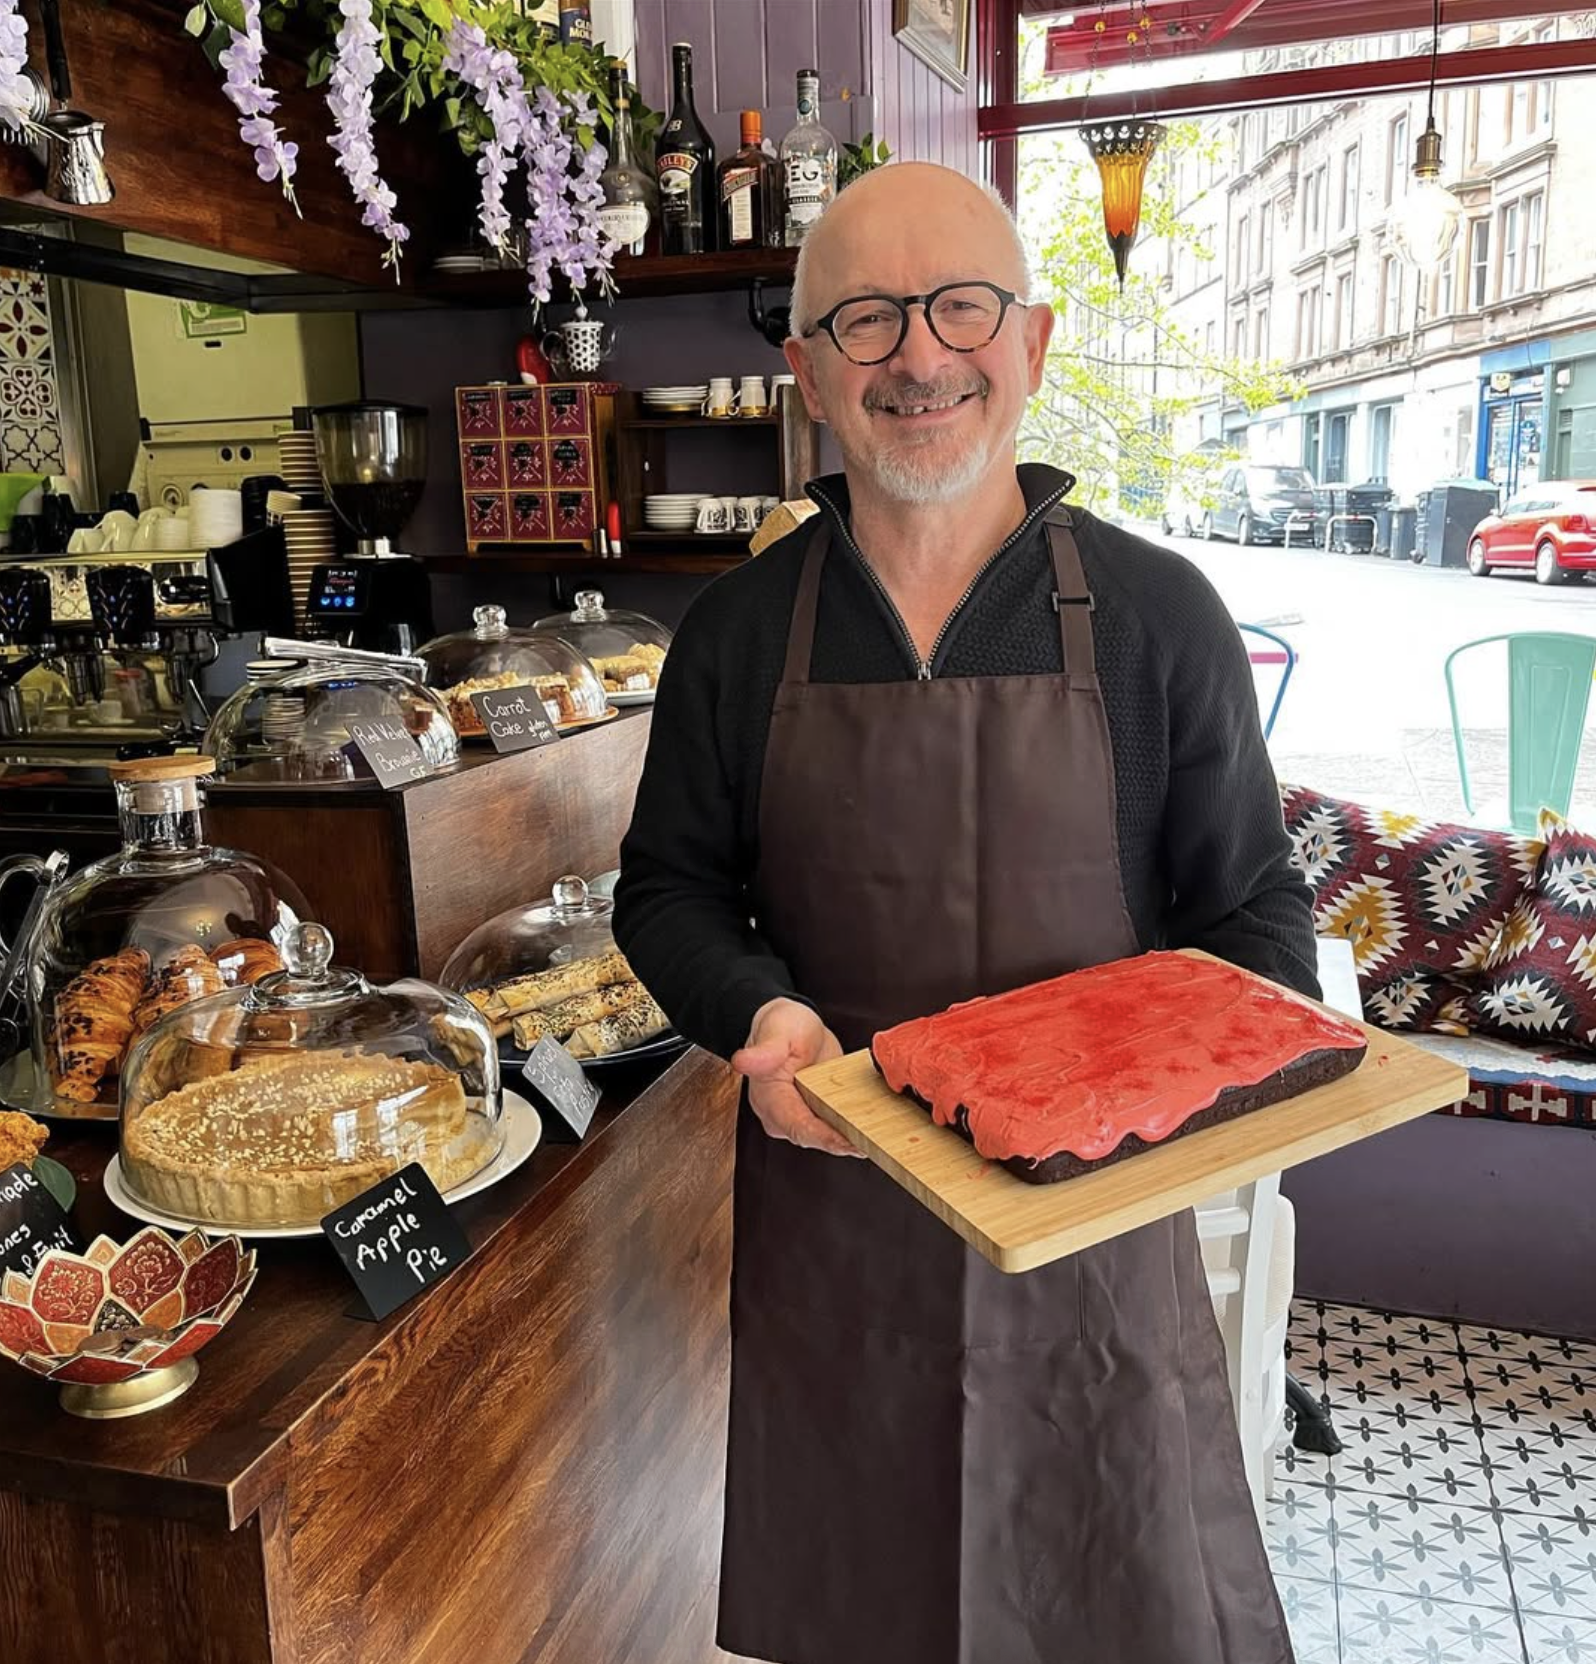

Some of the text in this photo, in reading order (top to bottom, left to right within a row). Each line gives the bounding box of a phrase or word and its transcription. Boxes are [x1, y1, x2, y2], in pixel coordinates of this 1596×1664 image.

[482, 695, 532, 718] Carrot
[352, 724, 381, 746] Red
[490, 720, 525, 738] Cake
[334, 1177, 418, 1238] Caramel
[356, 1213, 421, 1271] Apple
[406, 1245, 448, 1284] Pie
